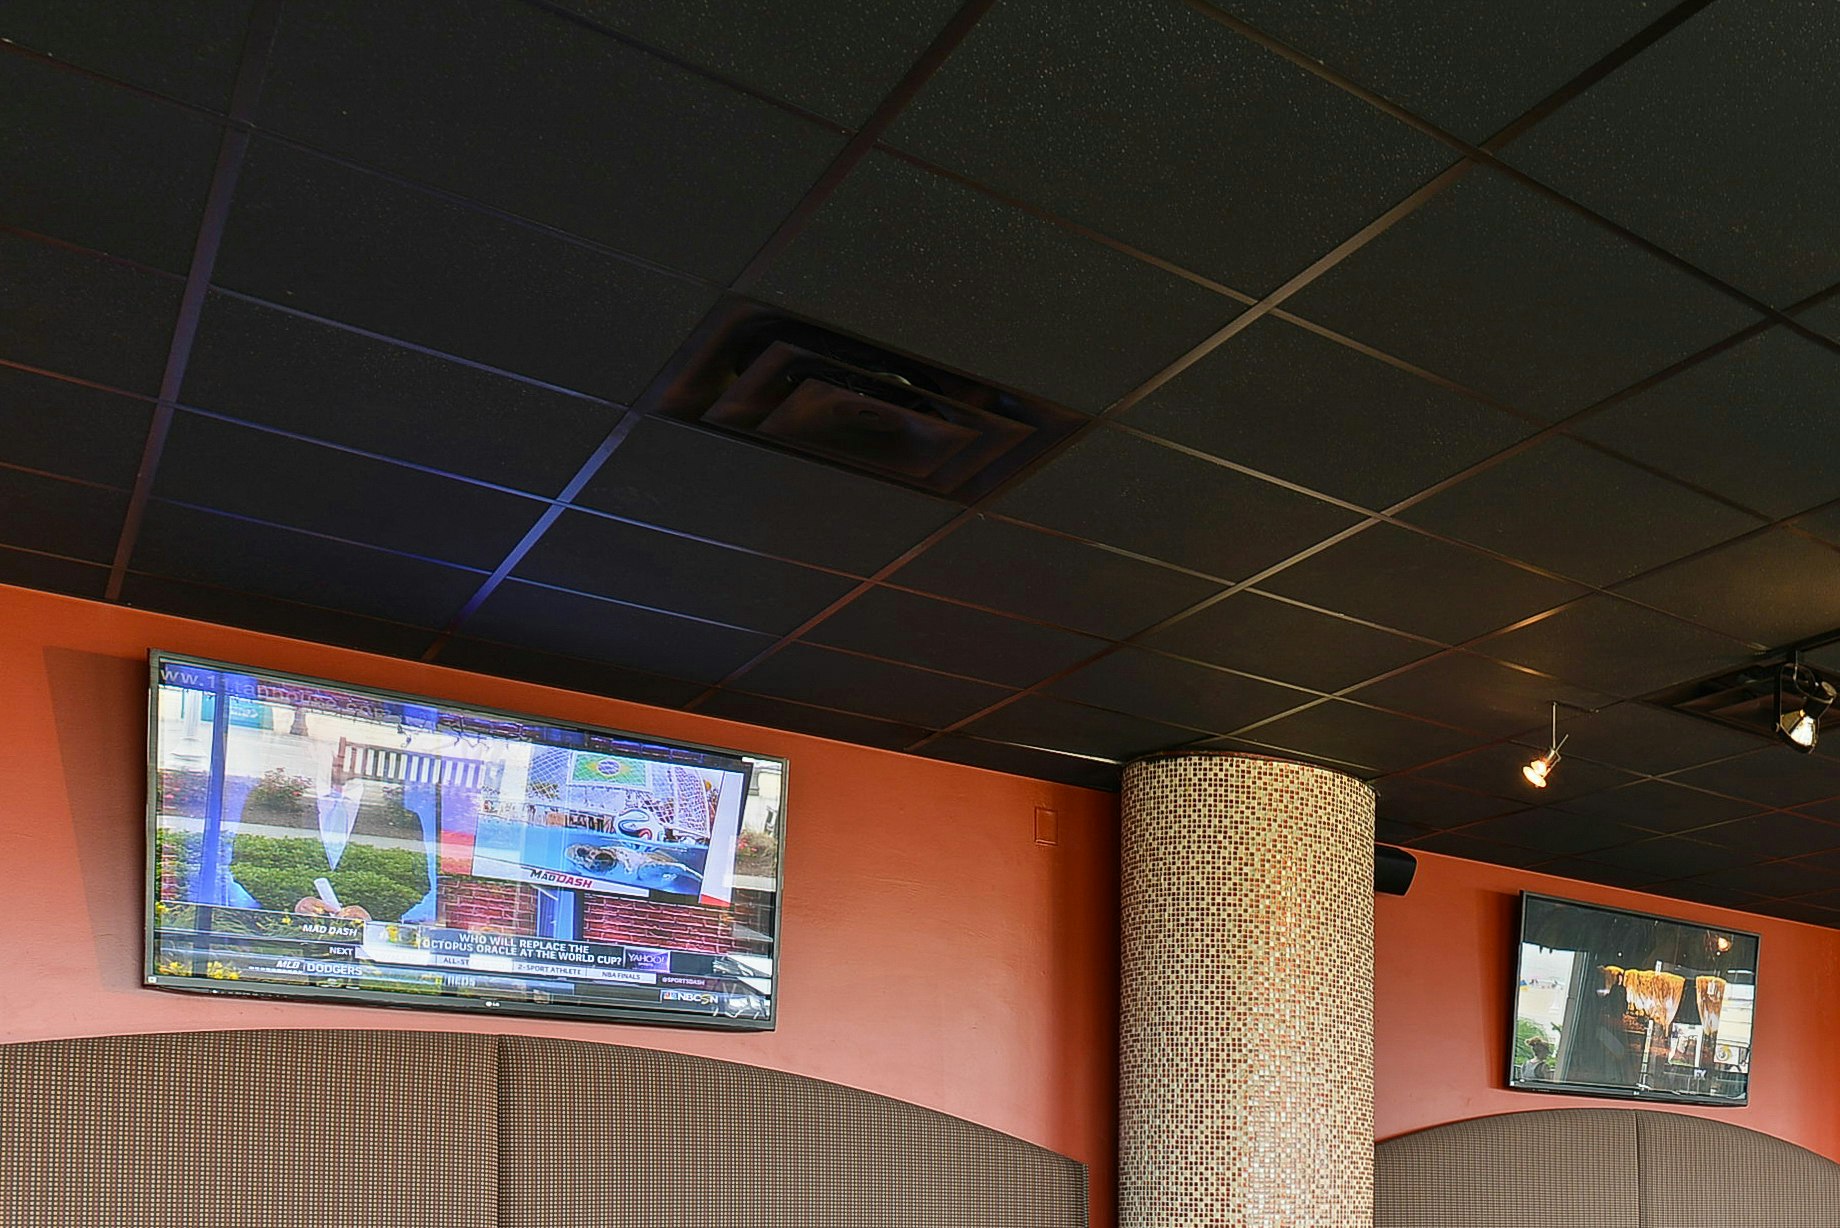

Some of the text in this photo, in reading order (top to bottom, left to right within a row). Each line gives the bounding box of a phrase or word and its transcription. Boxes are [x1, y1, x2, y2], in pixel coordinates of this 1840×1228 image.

[302, 924, 358, 937] MAD DASH
[459, 933, 590, 954] WHO WILL REPLACE THE
[329, 947, 354, 956] NEXT
[422, 938, 622, 966] OCTOPUS ORACLE AT THE WORLD CUP?
[627, 953, 664, 963] YAHOO!
[307, 964, 363, 976] DODGERS
[518, 964, 581, 976] 2-SPORT ATHLETE
[602, 971, 641, 981] NBA FINALS
[662, 976, 706, 986] @SPORTSDASH
[677, 993, 719, 1005] NBCSN
